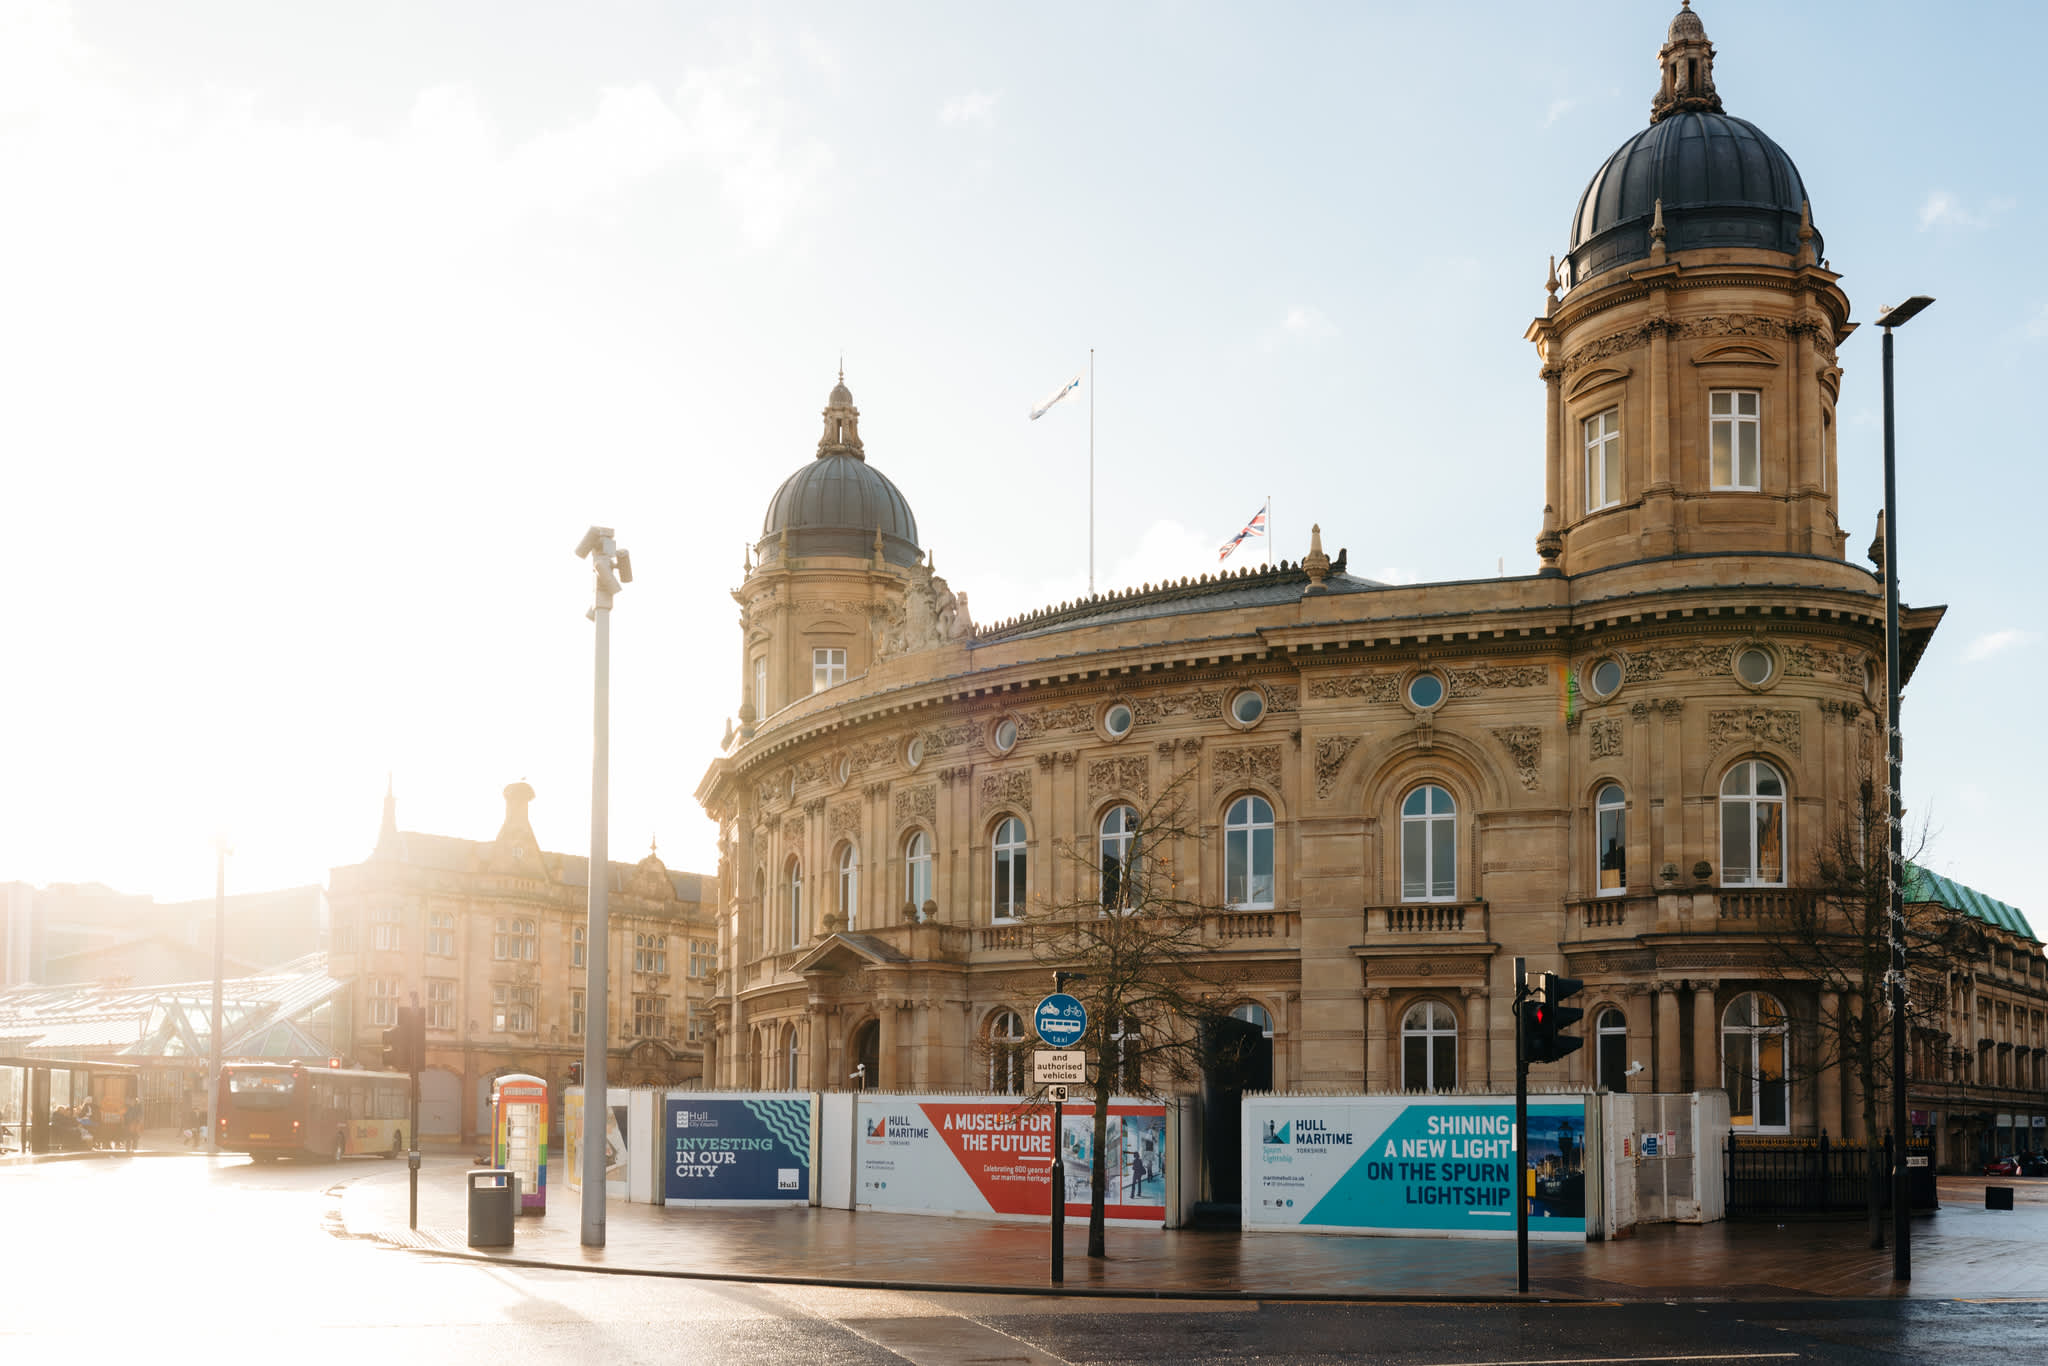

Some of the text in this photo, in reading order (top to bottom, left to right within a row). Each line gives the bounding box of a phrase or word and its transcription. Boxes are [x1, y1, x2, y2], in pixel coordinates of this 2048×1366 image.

[1037, 1063, 1083, 1071] authorised
[689, 1112, 708, 1120] Hull
[889, 1115, 910, 1126] HULL
[944, 1114, 1051, 1132] A MUSEUM FOR
[1296, 1120, 1327, 1131] HULL
[1427, 1115, 1510, 1135] SHINING
[889, 1128, 929, 1138] MARITIME
[676, 1138, 773, 1151] INVESTING
[961, 1134, 1051, 1153] THE FUTURE
[1296, 1134, 1353, 1145] MARITIME
[1384, 1139, 1510, 1159] A NEW LIGHT
[676, 1151, 737, 1164] IN OUR
[676, 1165, 718, 1177] CITY
[1028, 1167, 1044, 1175] years
[1367, 1162, 1510, 1182] ON THE SPURN
[1027, 1175, 1050, 1184] heritage
[1406, 1185, 1511, 1206] LIGHTSHIP
